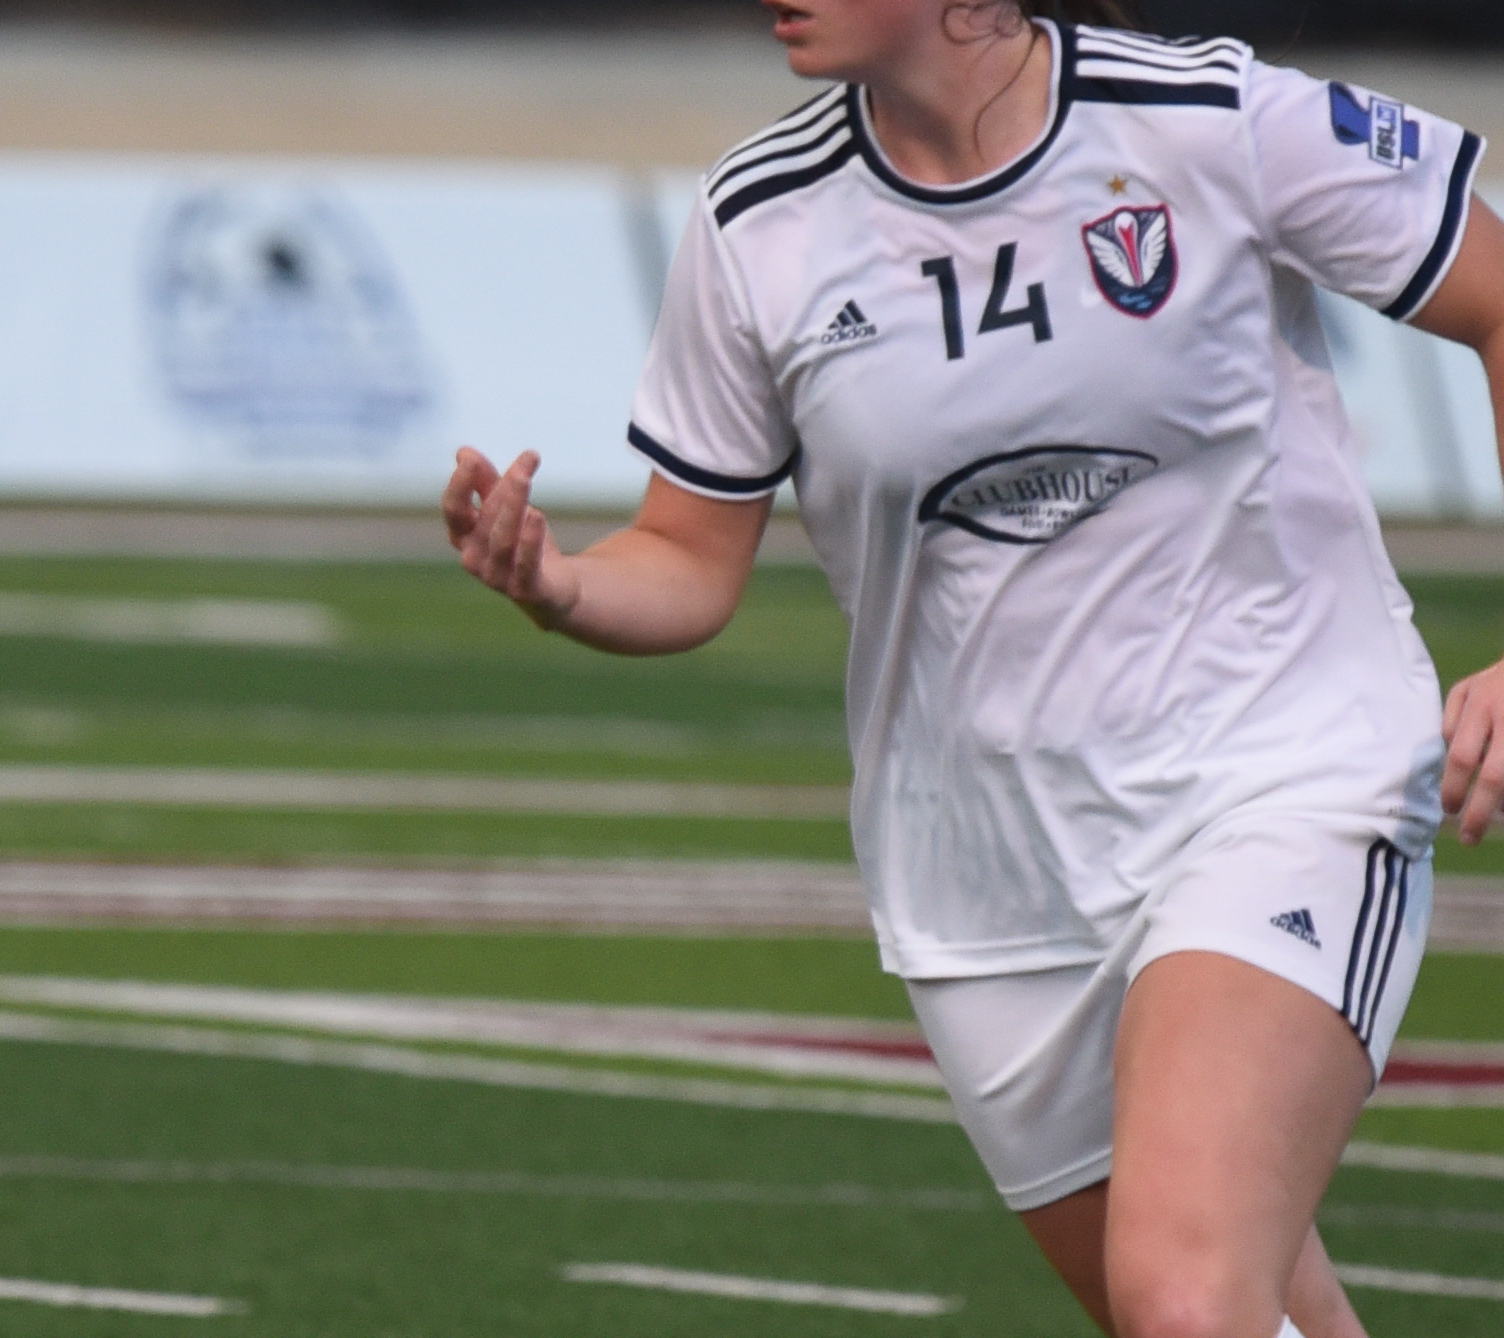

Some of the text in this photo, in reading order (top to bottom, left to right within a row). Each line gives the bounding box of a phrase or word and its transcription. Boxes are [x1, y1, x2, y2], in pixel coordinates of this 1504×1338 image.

[921, 241, 1053, 361] 14
[821, 324, 877, 344] adidas
[1270, 916, 1322, 951] adidas
